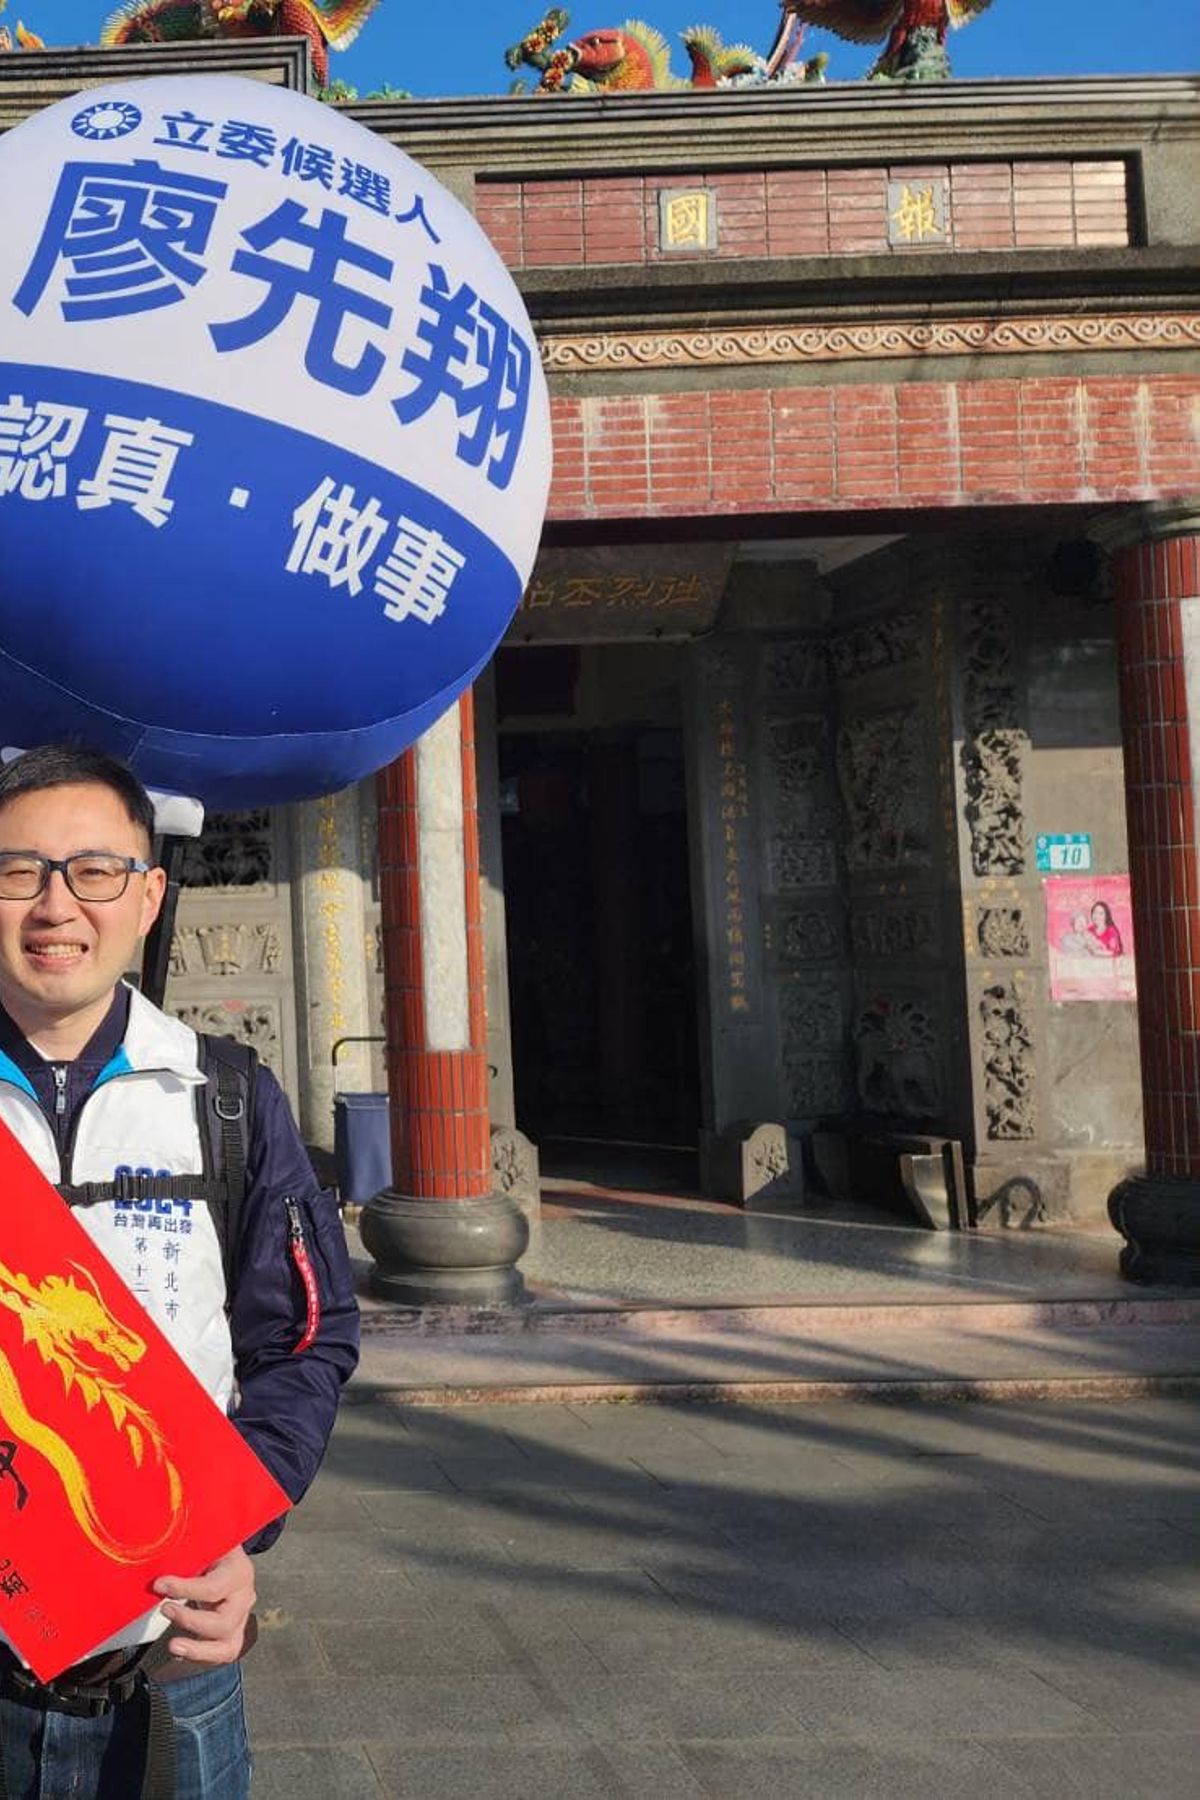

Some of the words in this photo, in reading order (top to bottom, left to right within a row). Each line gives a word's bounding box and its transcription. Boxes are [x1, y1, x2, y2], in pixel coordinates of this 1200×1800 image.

[154, 111, 443, 243] 立委候選人
[896, 187, 941, 239] 報
[665, 192, 708, 247] 國
[12, 159, 530, 490] 廖先翔
[114, 1213, 192, 1234] 台灣再出發
[132, 1236, 150, 1308] 第十二
[163, 1239, 180, 1321] 新北市
